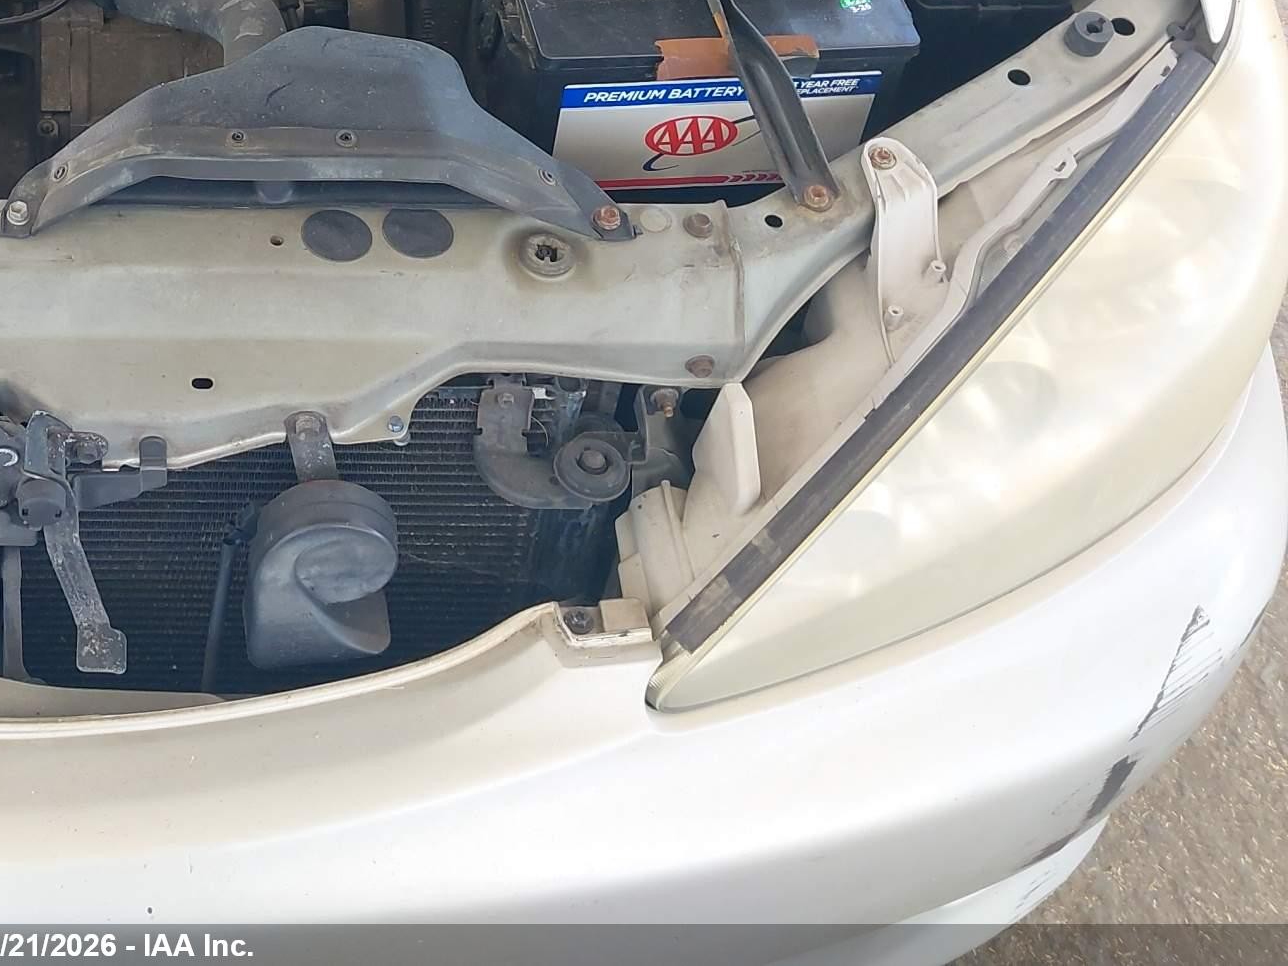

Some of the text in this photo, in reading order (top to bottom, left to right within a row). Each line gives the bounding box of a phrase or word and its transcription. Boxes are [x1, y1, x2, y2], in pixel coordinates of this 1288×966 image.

[795, 86, 857, 95] EPLACEMENT
[800, 80, 830, 89] YEAR
[829, 78, 861, 87] FREE
[583, 86, 744, 103] PREMIUM BATTERY
[650, 116, 732, 156] AAA
